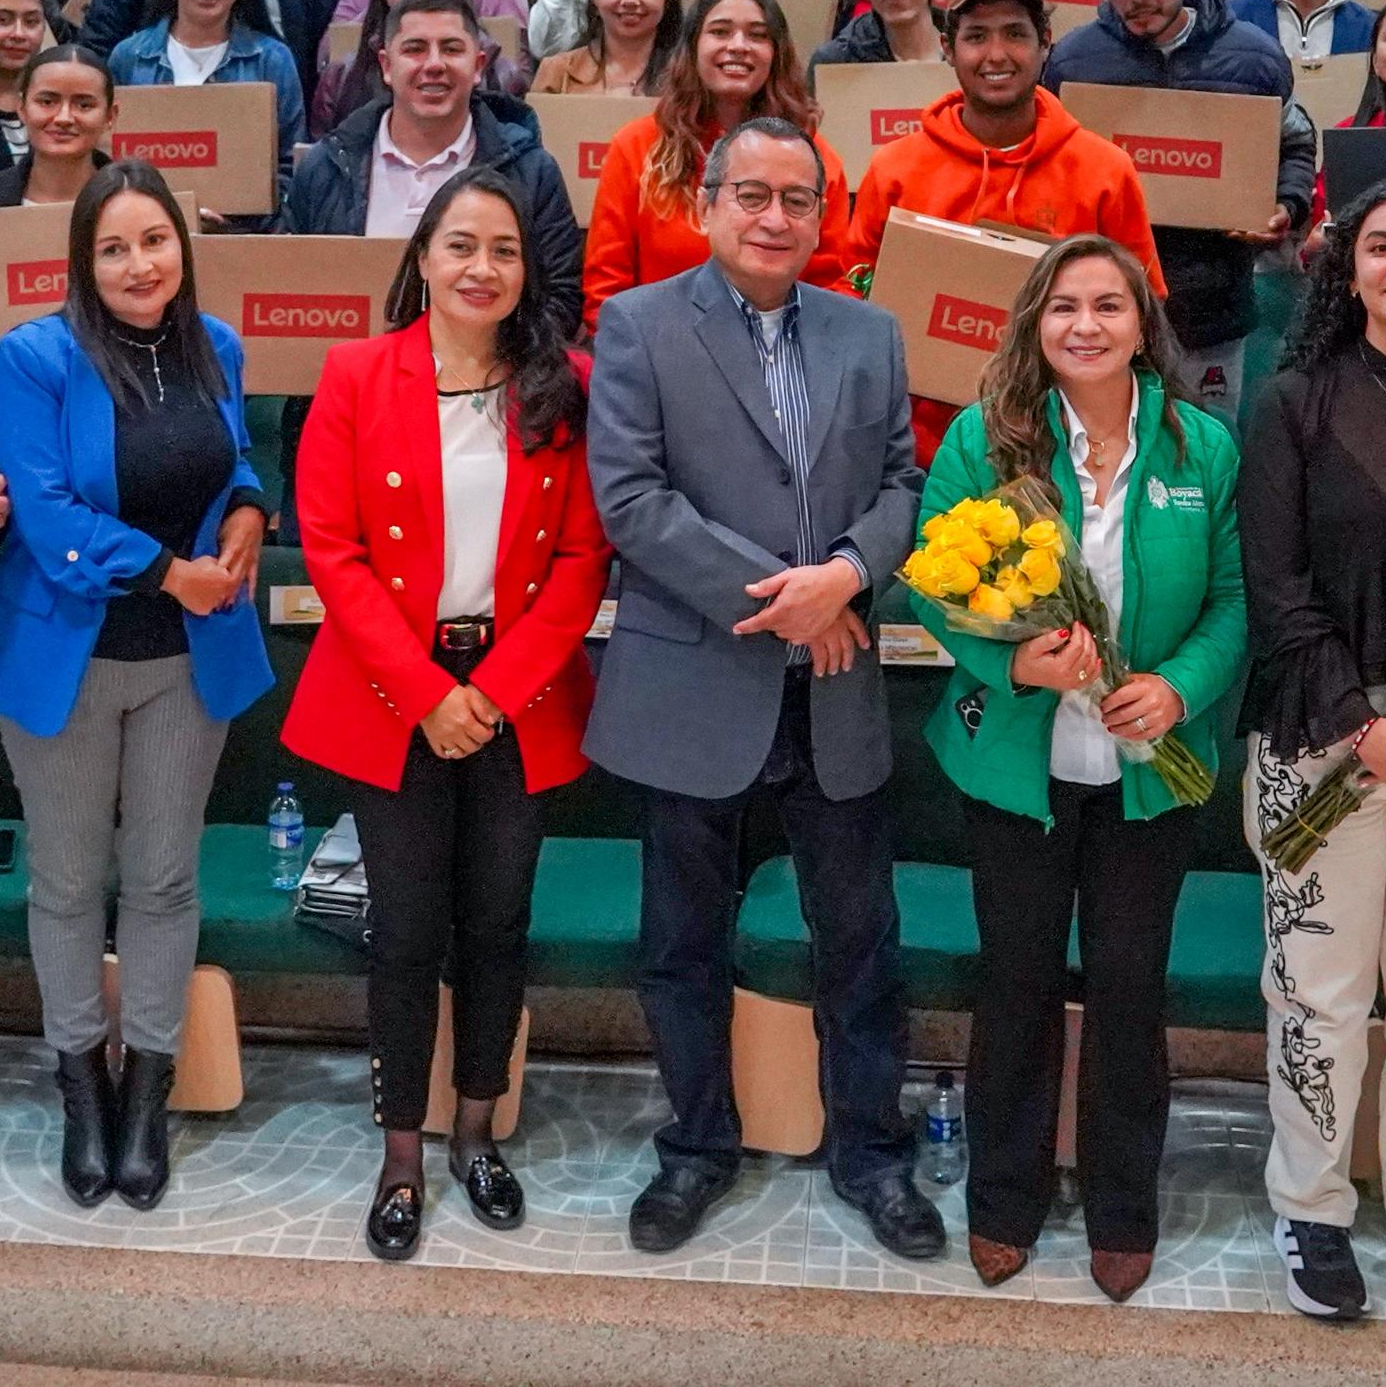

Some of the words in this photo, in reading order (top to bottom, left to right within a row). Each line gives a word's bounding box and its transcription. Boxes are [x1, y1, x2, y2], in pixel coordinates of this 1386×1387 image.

[880, 117, 923, 136] Len
[121, 141, 209, 159] Lenovo
[18, 272, 68, 294] Len
[253, 302, 359, 327] Lenovo
